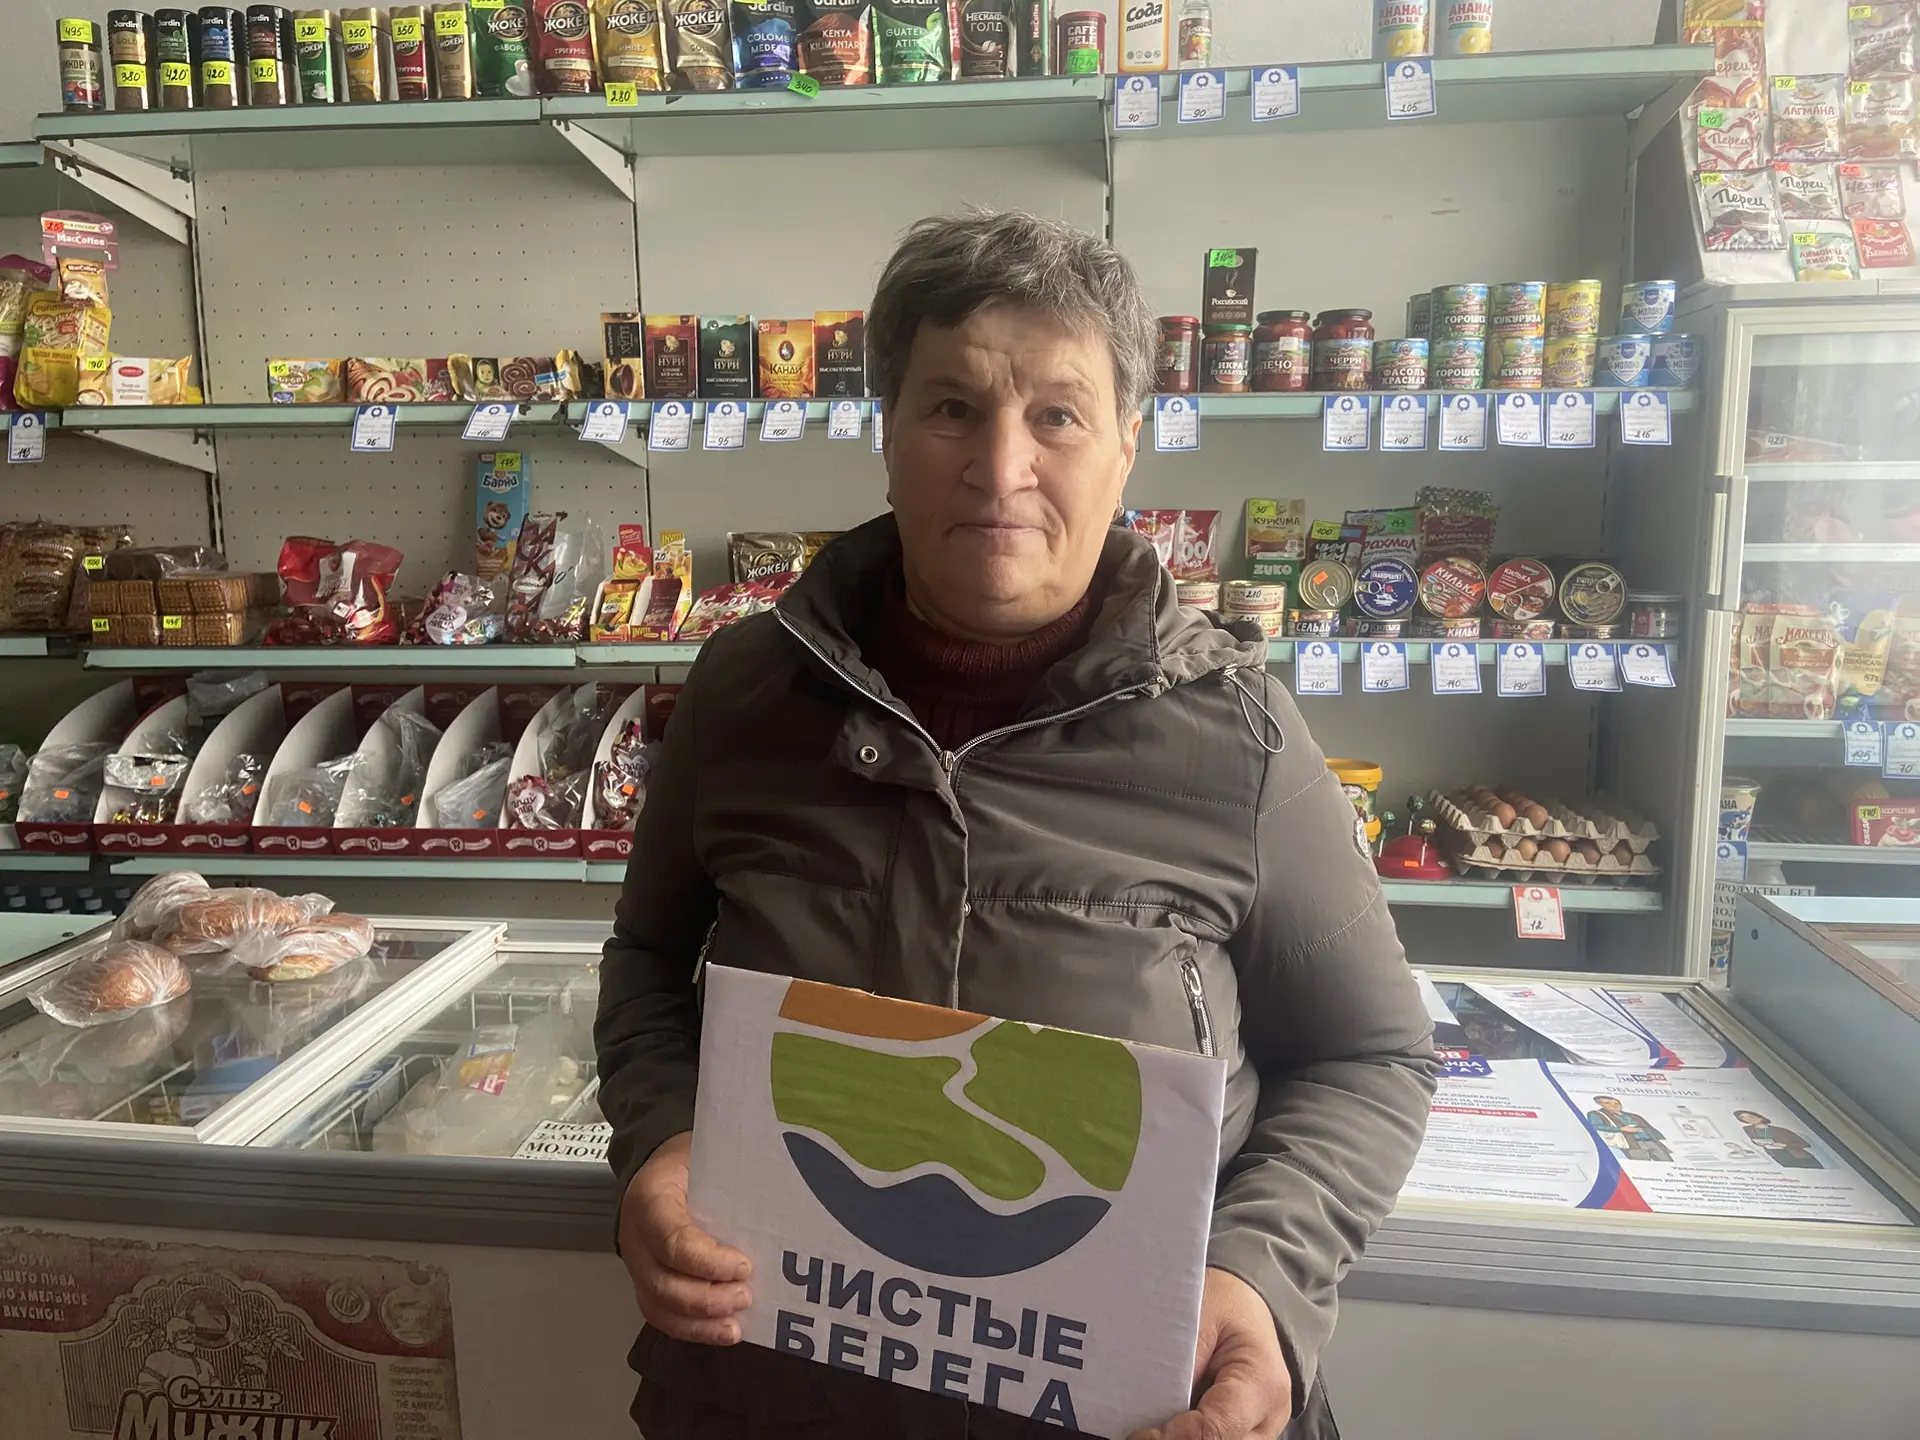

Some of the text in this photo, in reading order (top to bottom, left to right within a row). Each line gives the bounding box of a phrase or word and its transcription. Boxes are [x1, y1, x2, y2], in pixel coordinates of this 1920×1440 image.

[1126, 2, 1163, 22] Сода
[1379, 4, 1424, 19] АНАНАС
[1448, 3, 1492, 17] АНАНАС
[113, 19, 139, 28] Jardin
[157, 19, 181, 27] Jardin
[822, 29, 853, 39] KENYA
[1716, 61, 1751, 77] ерец
[1783, 106, 1835, 117] ЛАГМАНА
[1780, 176, 1828, 193] Перец
[1711, 189, 1767, 209] Перец
[56, 233, 105, 246] MacCoffee
[827, 350, 853, 361] НУРИ
[1329, 357, 1363, 366] ЧЕРРИ
[713, 360, 740, 370] НУРИ
[1383, 368, 1426, 377] ФАСОЛЬ
[1501, 367, 1543, 377] КУКУРУЗ
[482, 474, 518, 488] Барни
[1253, 516, 1301, 527] КУРКУМА
[1253, 564, 1293, 576] ZUKO
[1503, 567, 1533, 584] КИЛЬКА
[1296, 621, 1331, 633] СЕЛЬДЬ
[781, 1250, 1087, 1371] ЧИСТЫЕ
[775, 1309, 1080, 1432] БЕРЕГА
